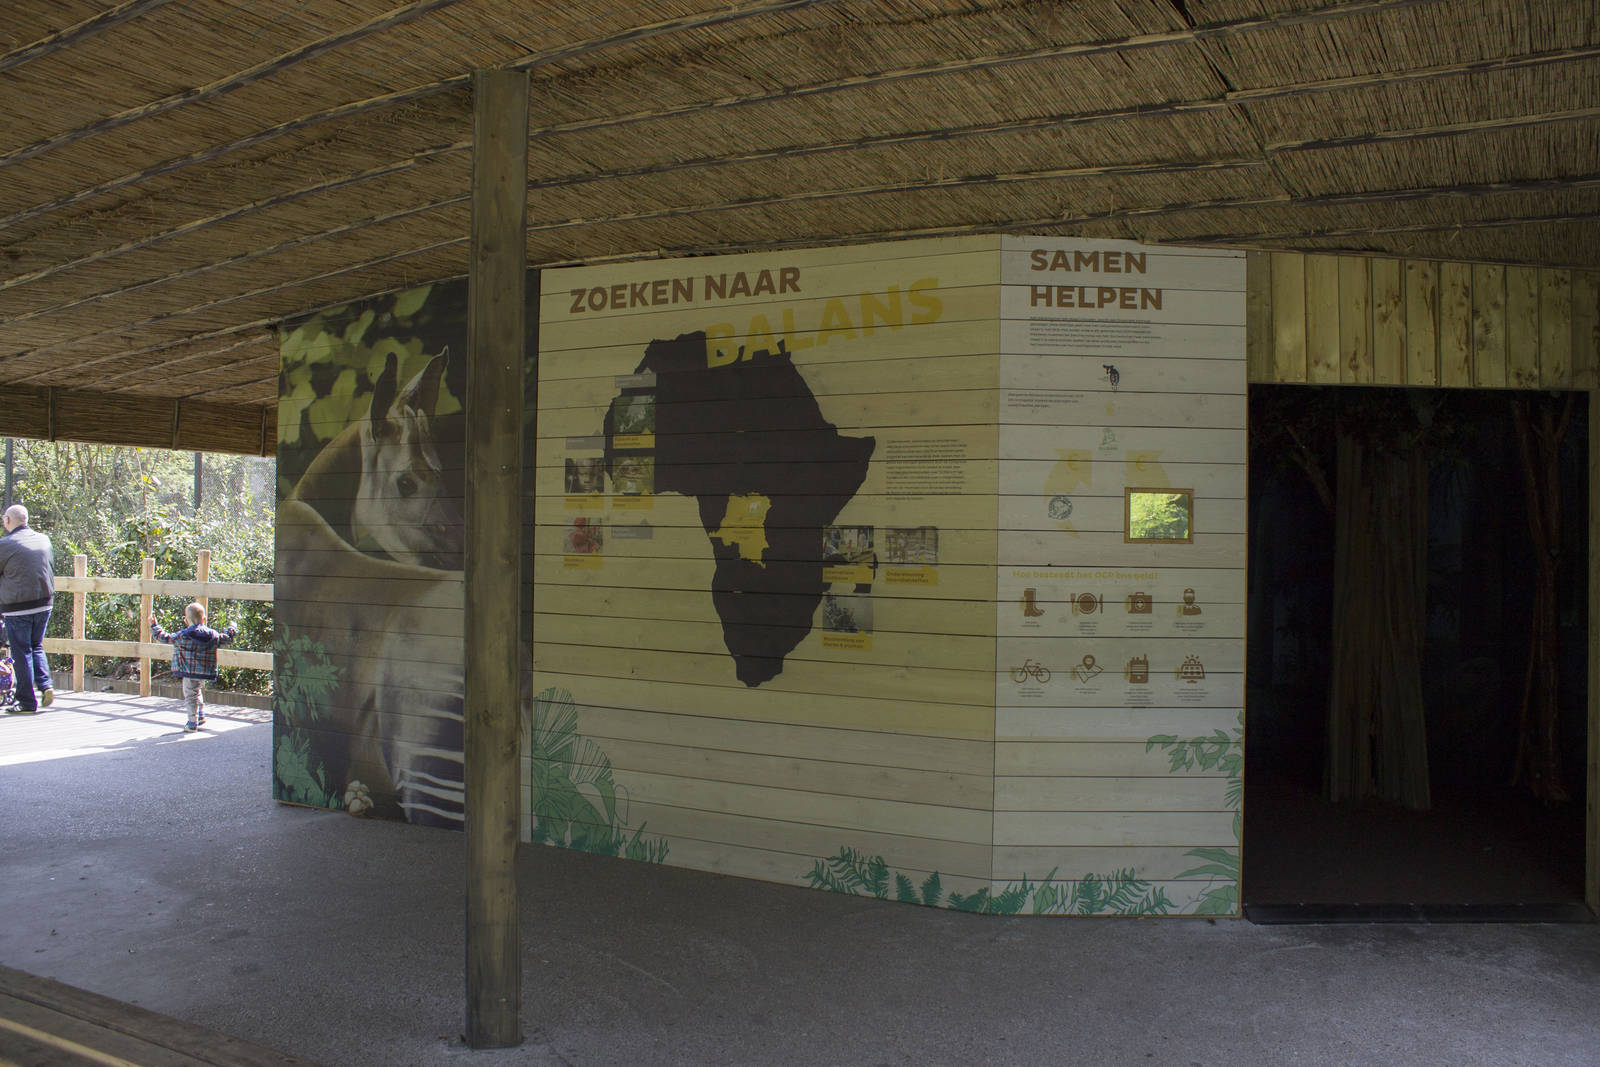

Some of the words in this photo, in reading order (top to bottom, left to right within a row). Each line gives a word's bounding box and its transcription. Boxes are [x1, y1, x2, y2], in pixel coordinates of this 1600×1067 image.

[1030, 249, 1147, 274] SAMEN
[569, 276, 694, 314] ZOEKEN
[704, 266, 802, 301] NAAR
[1030, 285, 1163, 311] HELPEN
[704, 277, 944, 369] BALANS
